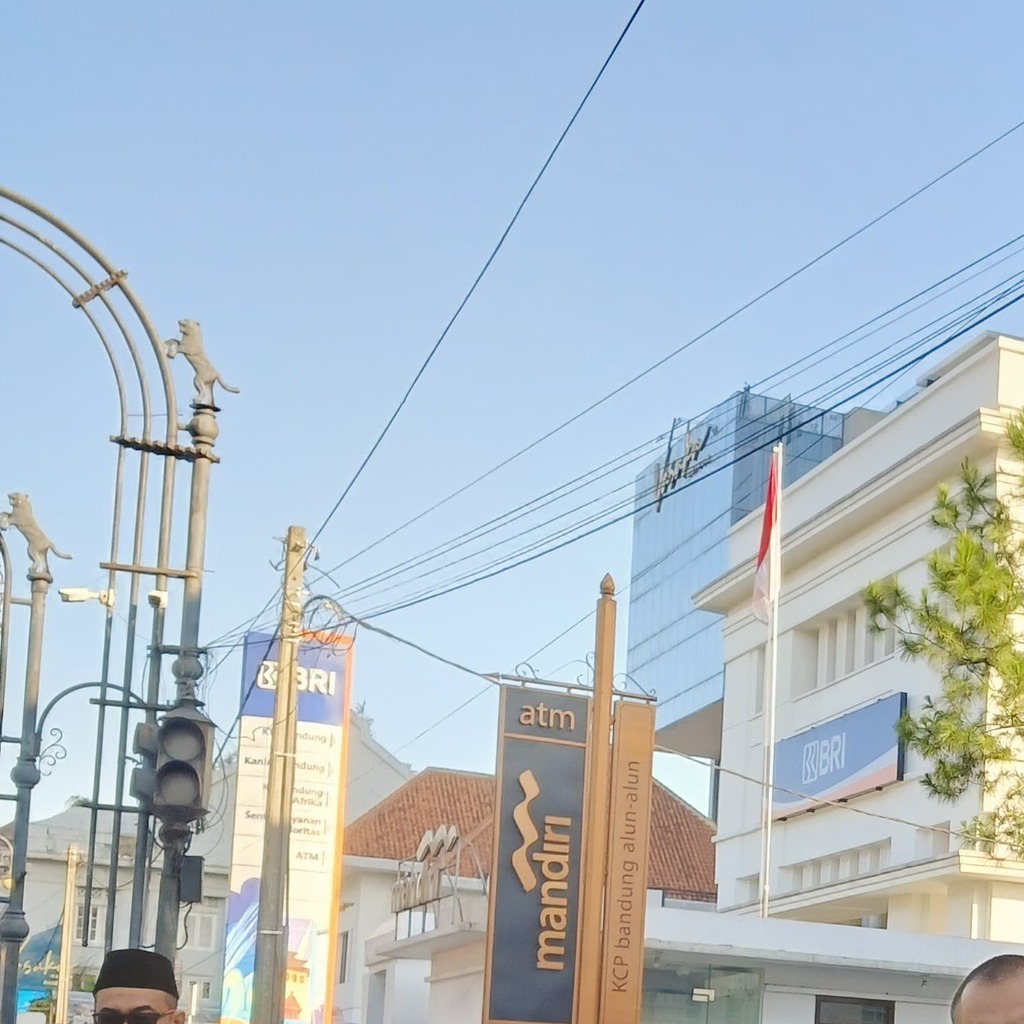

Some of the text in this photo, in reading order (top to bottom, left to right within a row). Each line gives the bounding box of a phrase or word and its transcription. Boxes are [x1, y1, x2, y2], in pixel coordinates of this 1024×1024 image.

[518, 702, 576, 732] atm
[818, 731, 847, 777] BRI
[295, 851, 320, 862] ATM
[611, 759, 641, 993] KCP bandung alun-alun
[532, 815, 573, 971] mandiri
